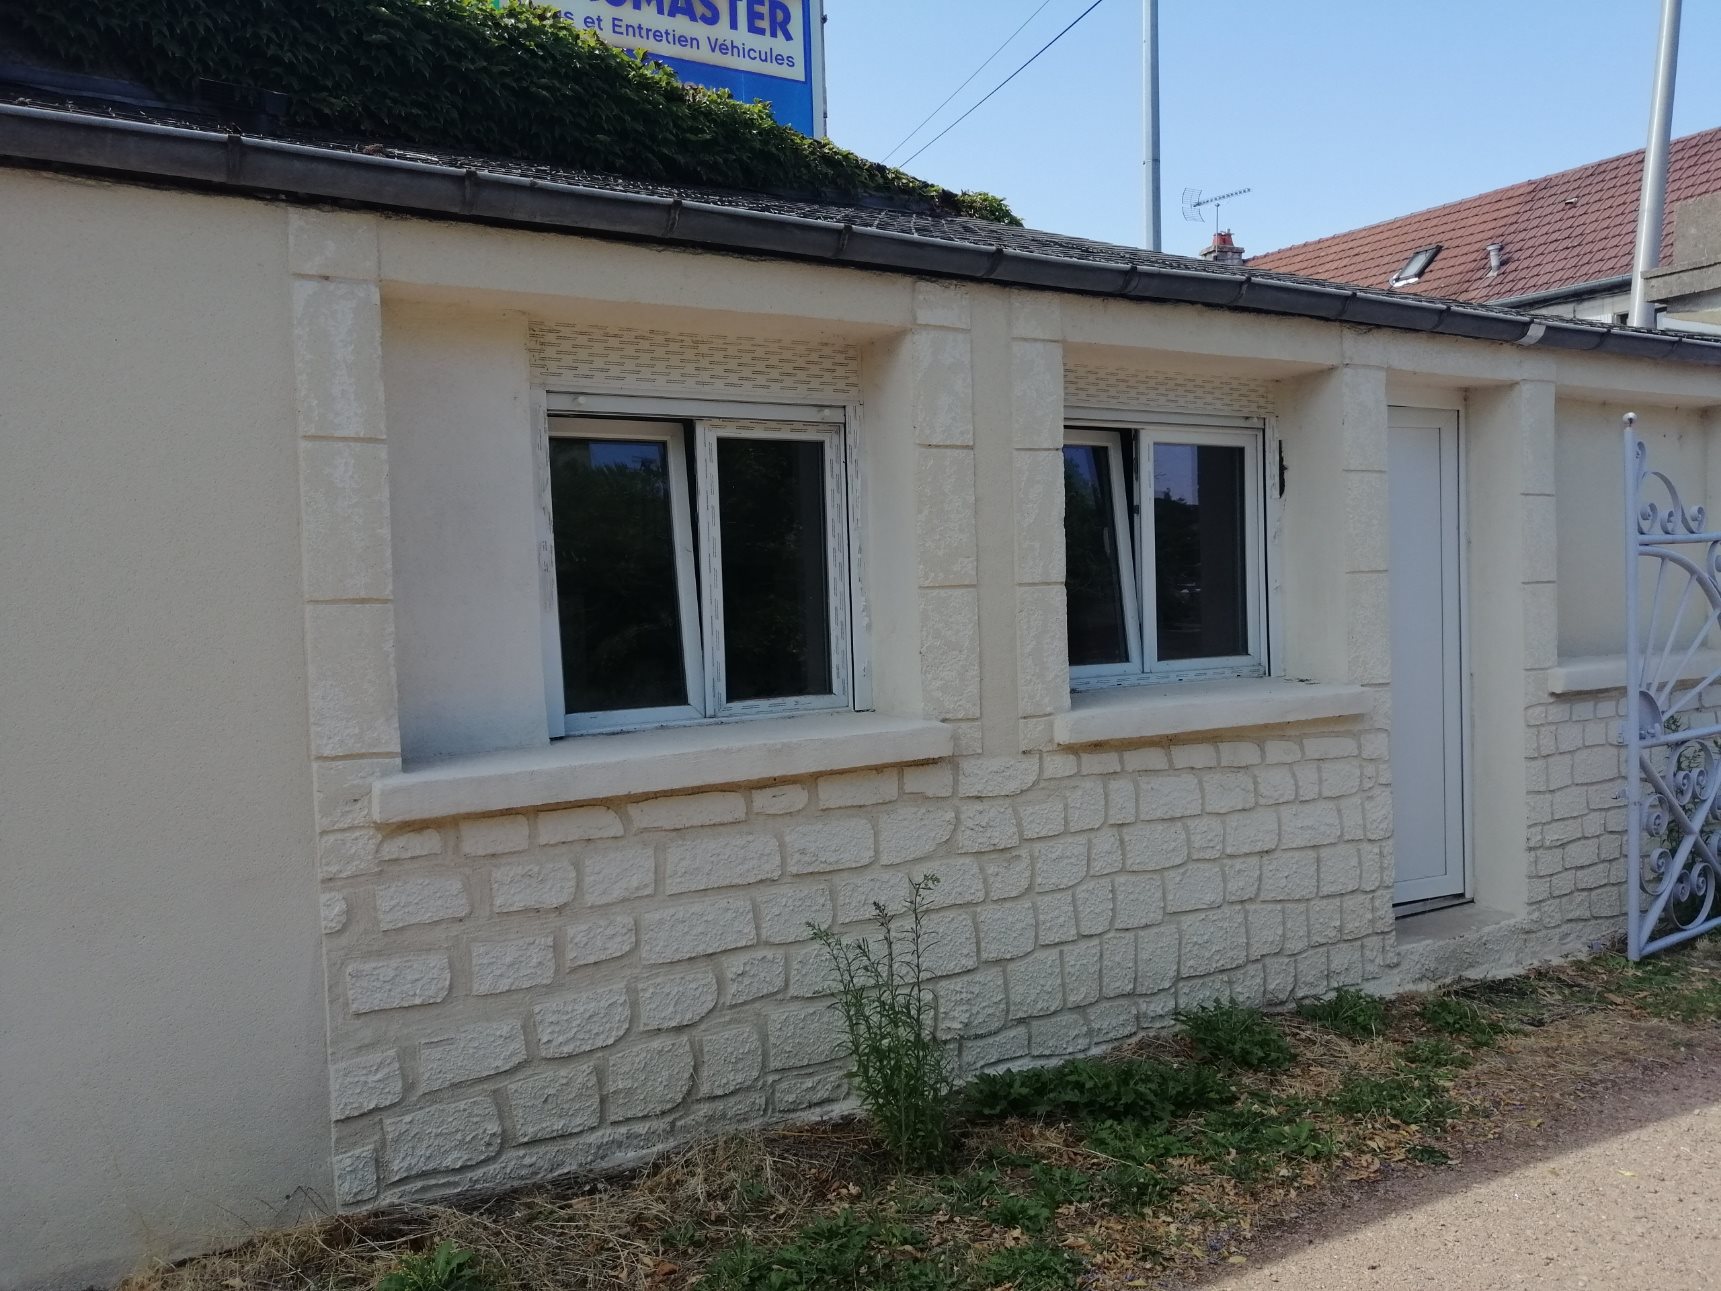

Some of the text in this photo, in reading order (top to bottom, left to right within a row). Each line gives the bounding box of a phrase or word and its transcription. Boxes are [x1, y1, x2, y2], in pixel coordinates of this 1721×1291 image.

[583, 15, 604, 32] et
[611, 17, 700, 50] Entretien
[706, 36, 795, 68] Véhicules
[604, 0, 794, 42] ASTER
